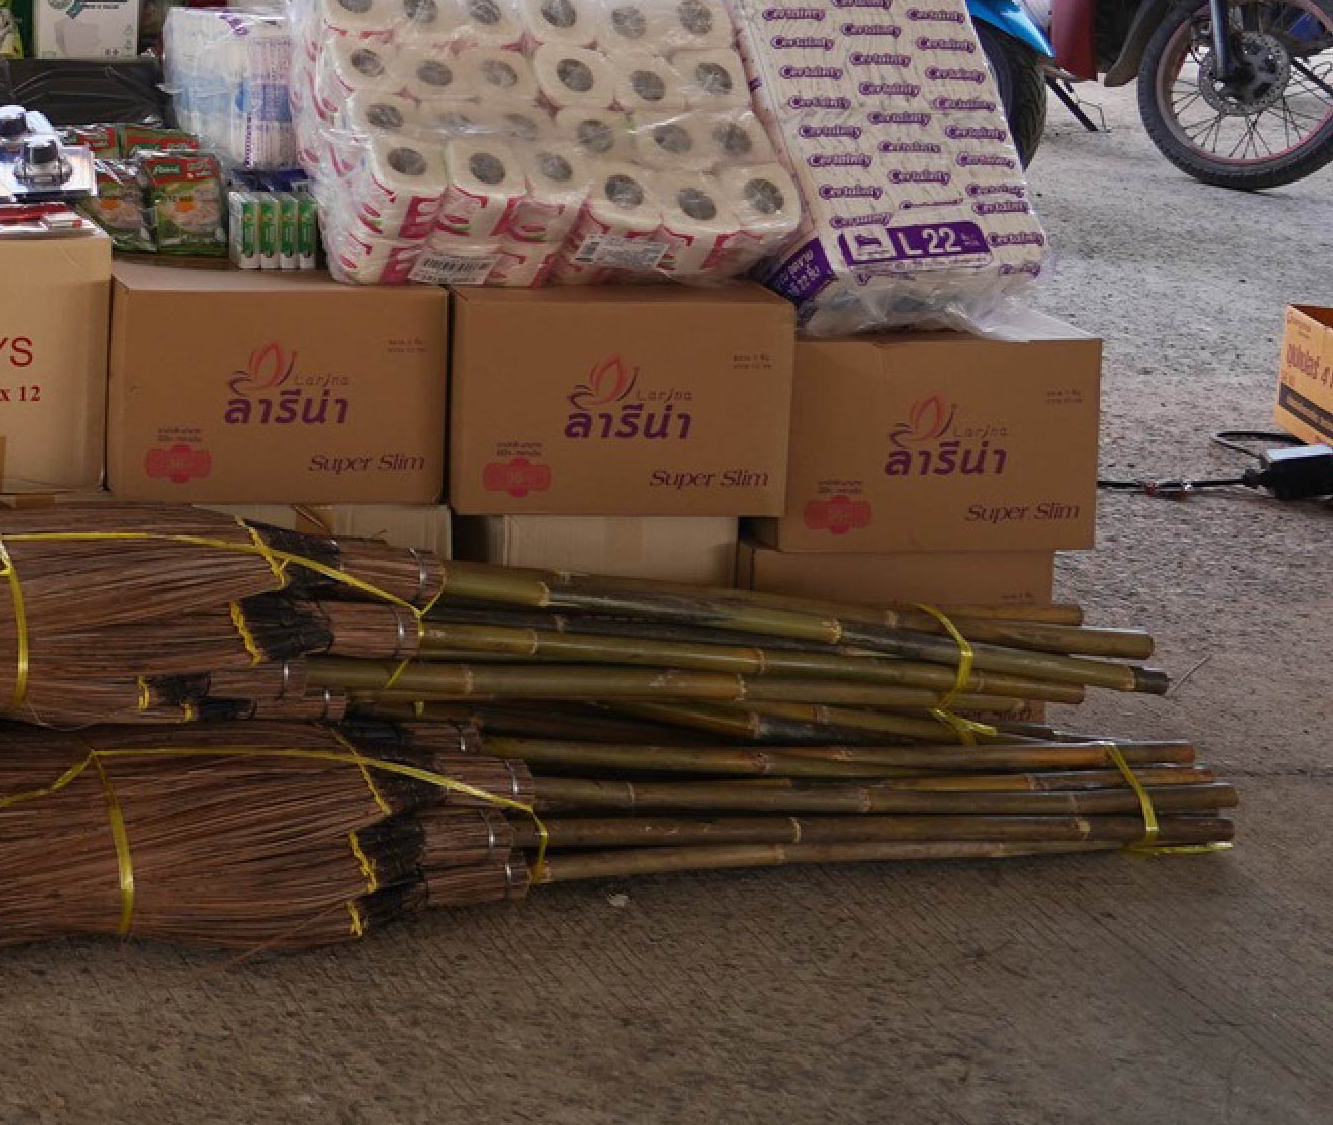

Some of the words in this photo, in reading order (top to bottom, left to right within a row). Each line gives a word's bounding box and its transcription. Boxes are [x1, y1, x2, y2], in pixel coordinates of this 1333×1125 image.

[896, 231, 923, 258] L
[922, 227, 963, 253] 22
[0, 391, 12, 402] x
[19, 385, 41, 402] 12
[223, 389, 349, 424] ลารีน่า
[564, 404, 692, 440] ลารีน่า
[307, 455, 373, 473] Super
[377, 453, 425, 472] Slim
[884, 439, 1007, 476] ลารีน่า
[648, 469, 716, 490] Super
[720, 468, 769, 487] Slim
[964, 503, 1030, 523] Super
[1033, 502, 1081, 520] Slim
